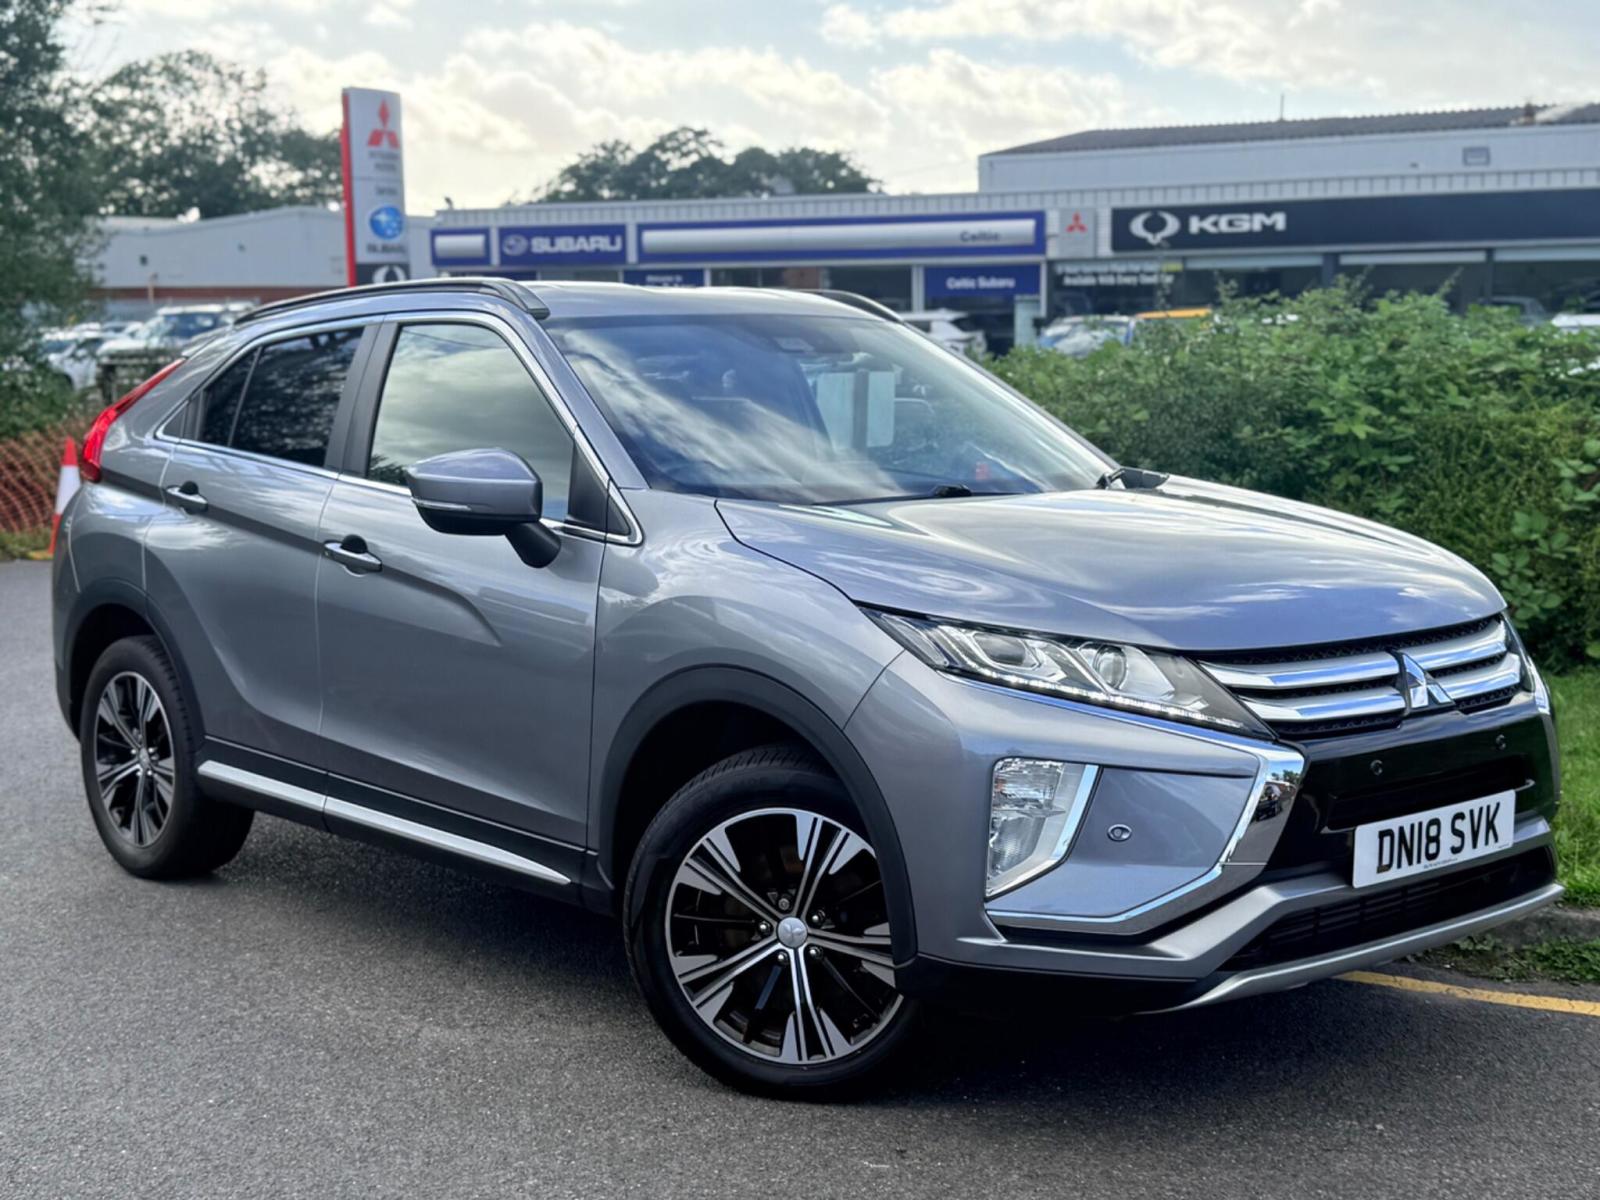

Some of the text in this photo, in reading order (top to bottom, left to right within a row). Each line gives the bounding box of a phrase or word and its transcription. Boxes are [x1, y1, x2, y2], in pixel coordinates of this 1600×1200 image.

[1188, 212, 1286, 234] KGM
[530, 235, 622, 253] SUBARU
[1376, 802, 1501, 874] DN18 SVK
